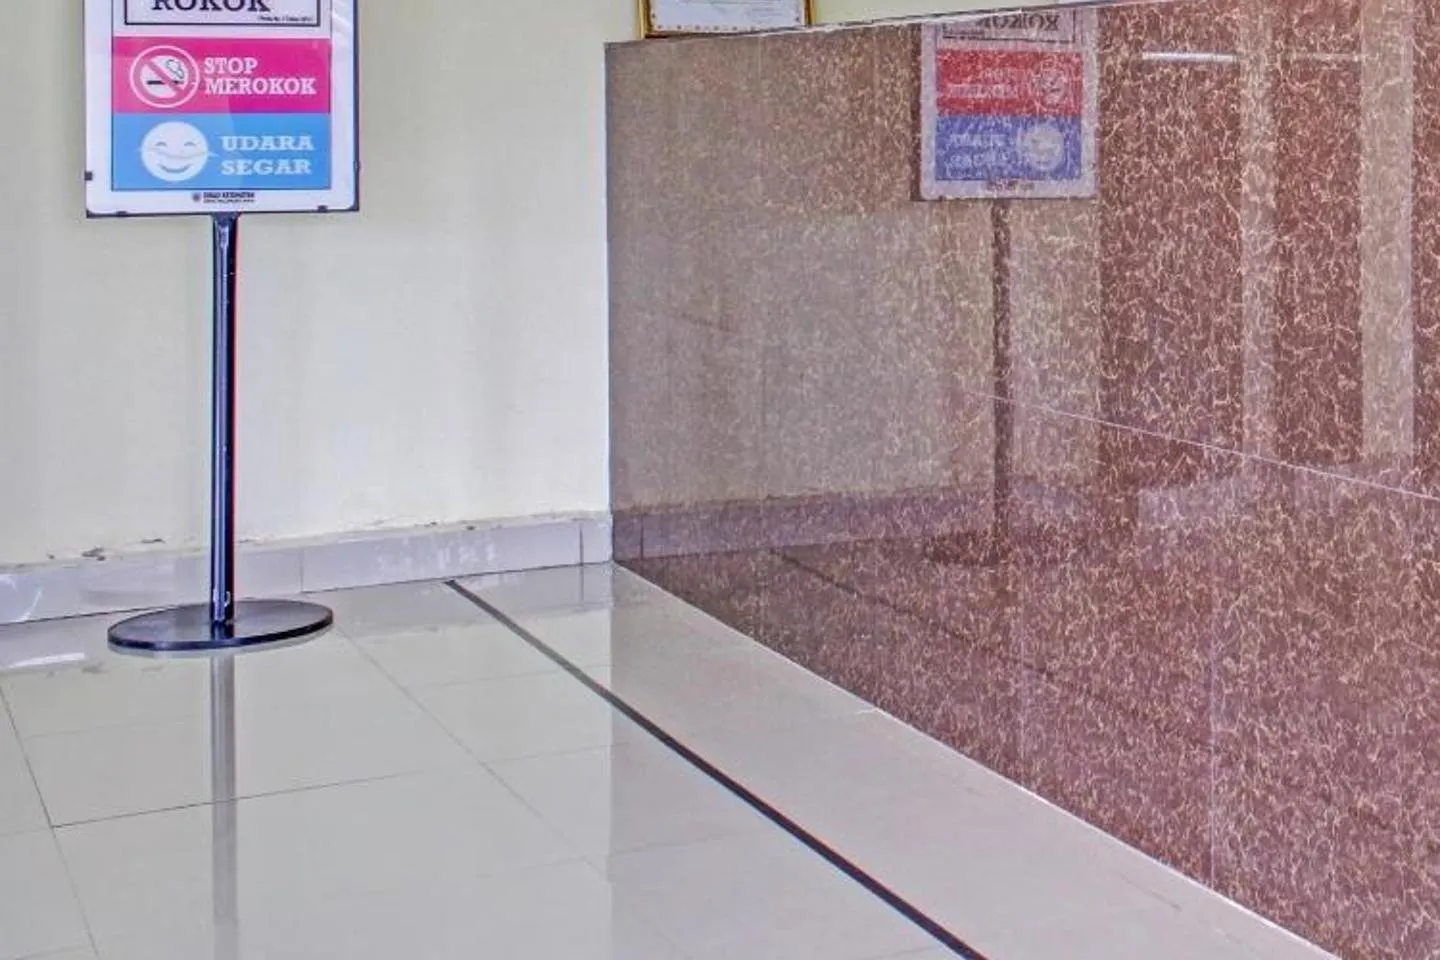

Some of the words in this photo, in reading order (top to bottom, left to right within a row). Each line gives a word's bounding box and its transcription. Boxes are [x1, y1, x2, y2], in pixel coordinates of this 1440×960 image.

[203, 56, 258, 75] STOP
[204, 77, 317, 95] MEROKOK
[220, 135, 315, 151] UDARA
[221, 158, 312, 176] SEGAR
